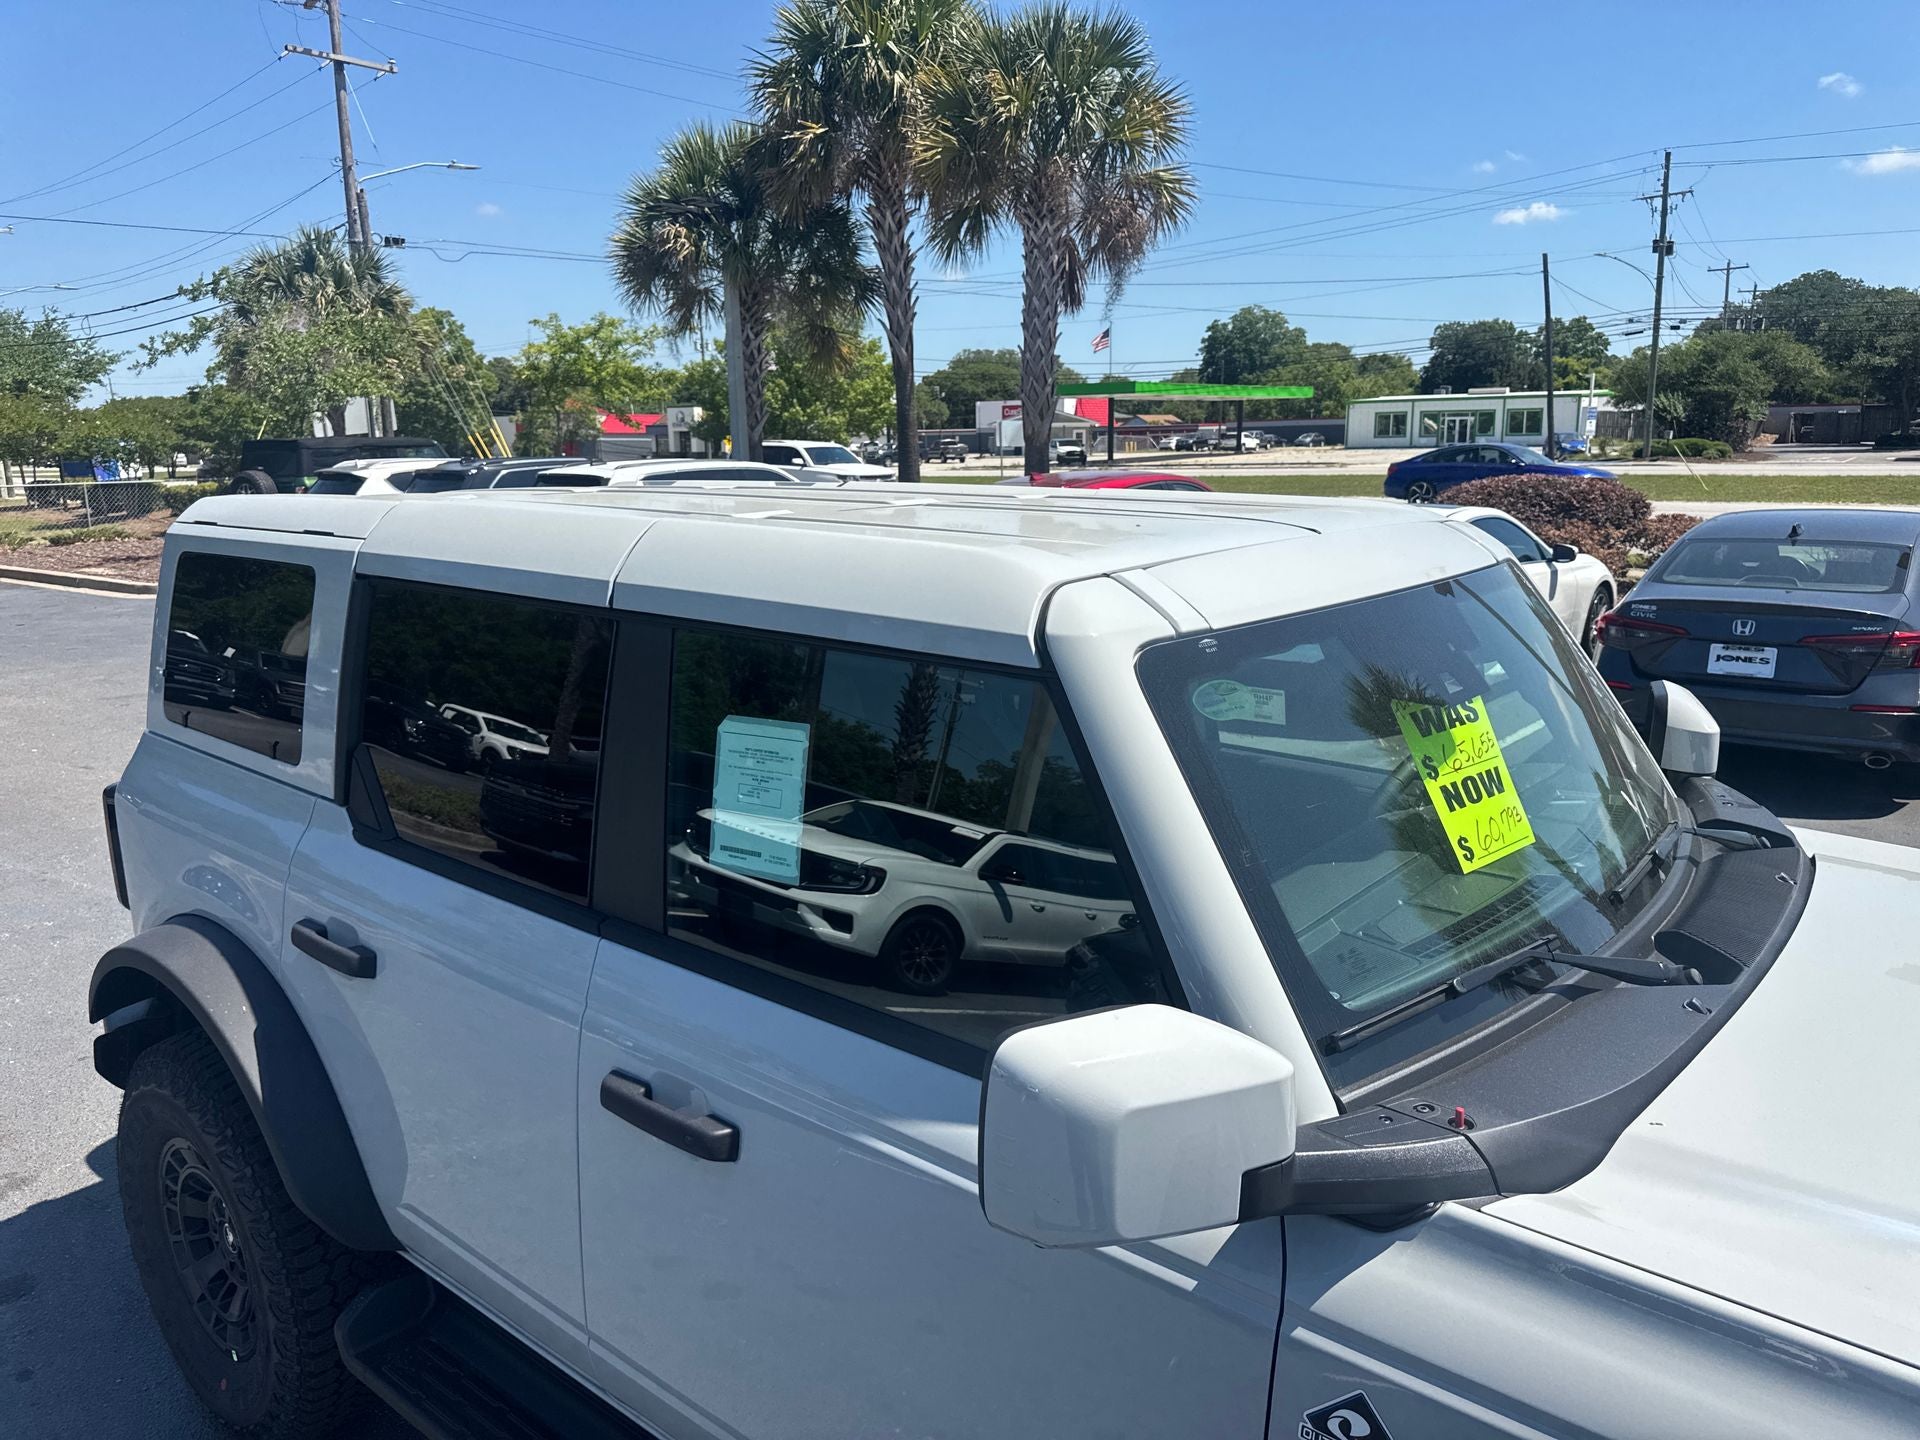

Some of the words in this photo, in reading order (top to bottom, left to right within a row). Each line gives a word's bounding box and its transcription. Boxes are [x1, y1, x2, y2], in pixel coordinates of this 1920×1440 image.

[1630, 611, 1657, 619] CIVIC
[1714, 654, 1771, 665] JONES
[1409, 700, 1480, 738] WAS
[1420, 754, 1440, 781] $
[1439, 766, 1506, 813] NOW
[1456, 835, 1475, 864] $
